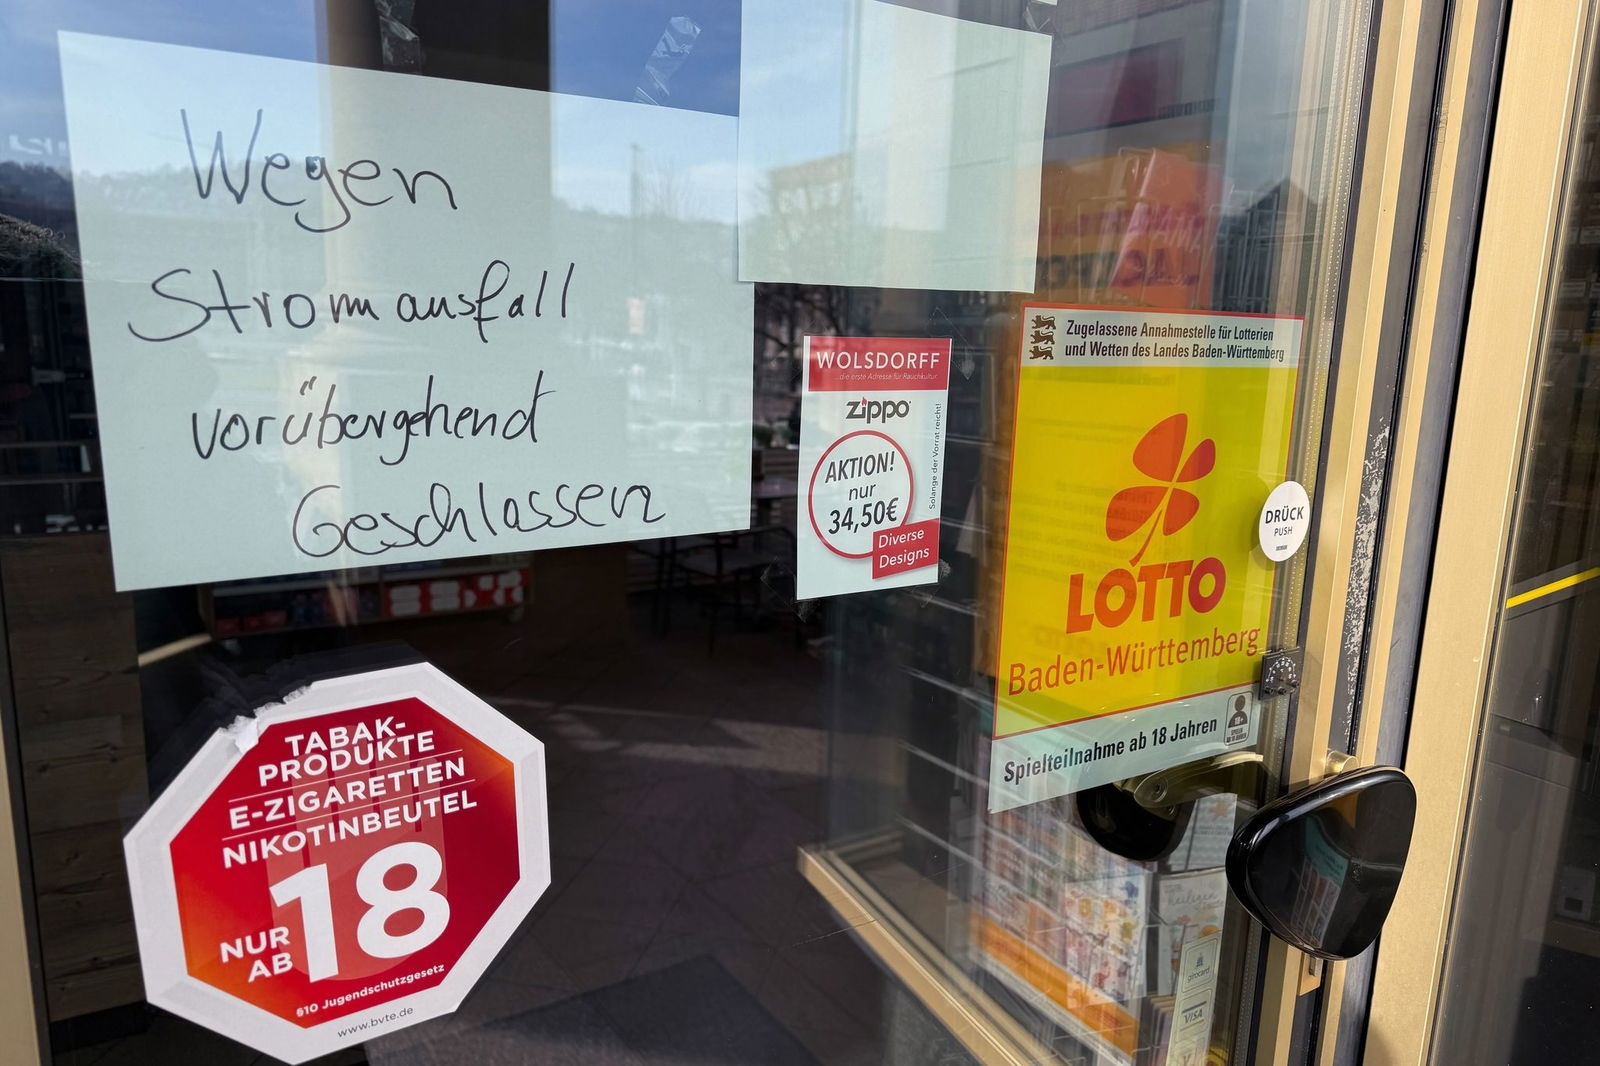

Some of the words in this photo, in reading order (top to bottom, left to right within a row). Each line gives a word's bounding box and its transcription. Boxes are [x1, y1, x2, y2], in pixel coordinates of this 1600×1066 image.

[180, 109, 458, 232] Wegen
[128, 260, 575, 343] Stromausfall
[1066, 320, 1137, 338] Zugelassene
[1140, 322, 1216, 339] Annahmestelle
[1218, 322, 1232, 340] für
[1234, 325, 1274, 341] Lotterien
[816, 351, 941, 369] WOLSDORFF
[1065, 342, 1086, 357] und
[1090, 341, 1129, 357] Wetten
[1132, 342, 1150, 357] des
[1153, 343, 1190, 358] Landes
[1192, 344, 1285, 362] Baden-Württemberg
[192, 370, 557, 466] vorübergehend
[932, 432, 940, 458] Vorrat
[825, 451, 896, 483] AKTION!
[848, 482, 876, 501] nur
[929, 475, 938, 509] Solange
[828, 497, 899, 535] 34,50€
[1265, 505, 1304, 524] DRÜCK
[1274, 526, 1293, 536] PUSH
[878, 528, 925, 549] Diverse
[879, 547, 930, 570] Designs
[1066, 557, 1227, 634] LOTTO
[1008, 627, 1262, 696] Baden-Württemberg
[285, 717, 406, 757] TABAK-
[1004, 741, 1125, 785] Spielteilnahme
[1129, 732, 1147, 753] ab
[1152, 726, 1167, 747] 18
[1170, 717, 1218, 743] Jahren
[258, 731, 435, 787] PRODUKTE
[228, 757, 465, 831] E-ZIGARETTEN
[223, 790, 477, 868] NIKOTINBEUTEL
[269, 842, 450, 983] 18
[219, 926, 290, 963] NUR
[248, 953, 294, 983] AB
[323, 964, 445, 1009] Jugendschutzgesetz
[337, 1006, 414, 1038] www.bvte.de
[1184, 1009, 1203, 1024] VISA
